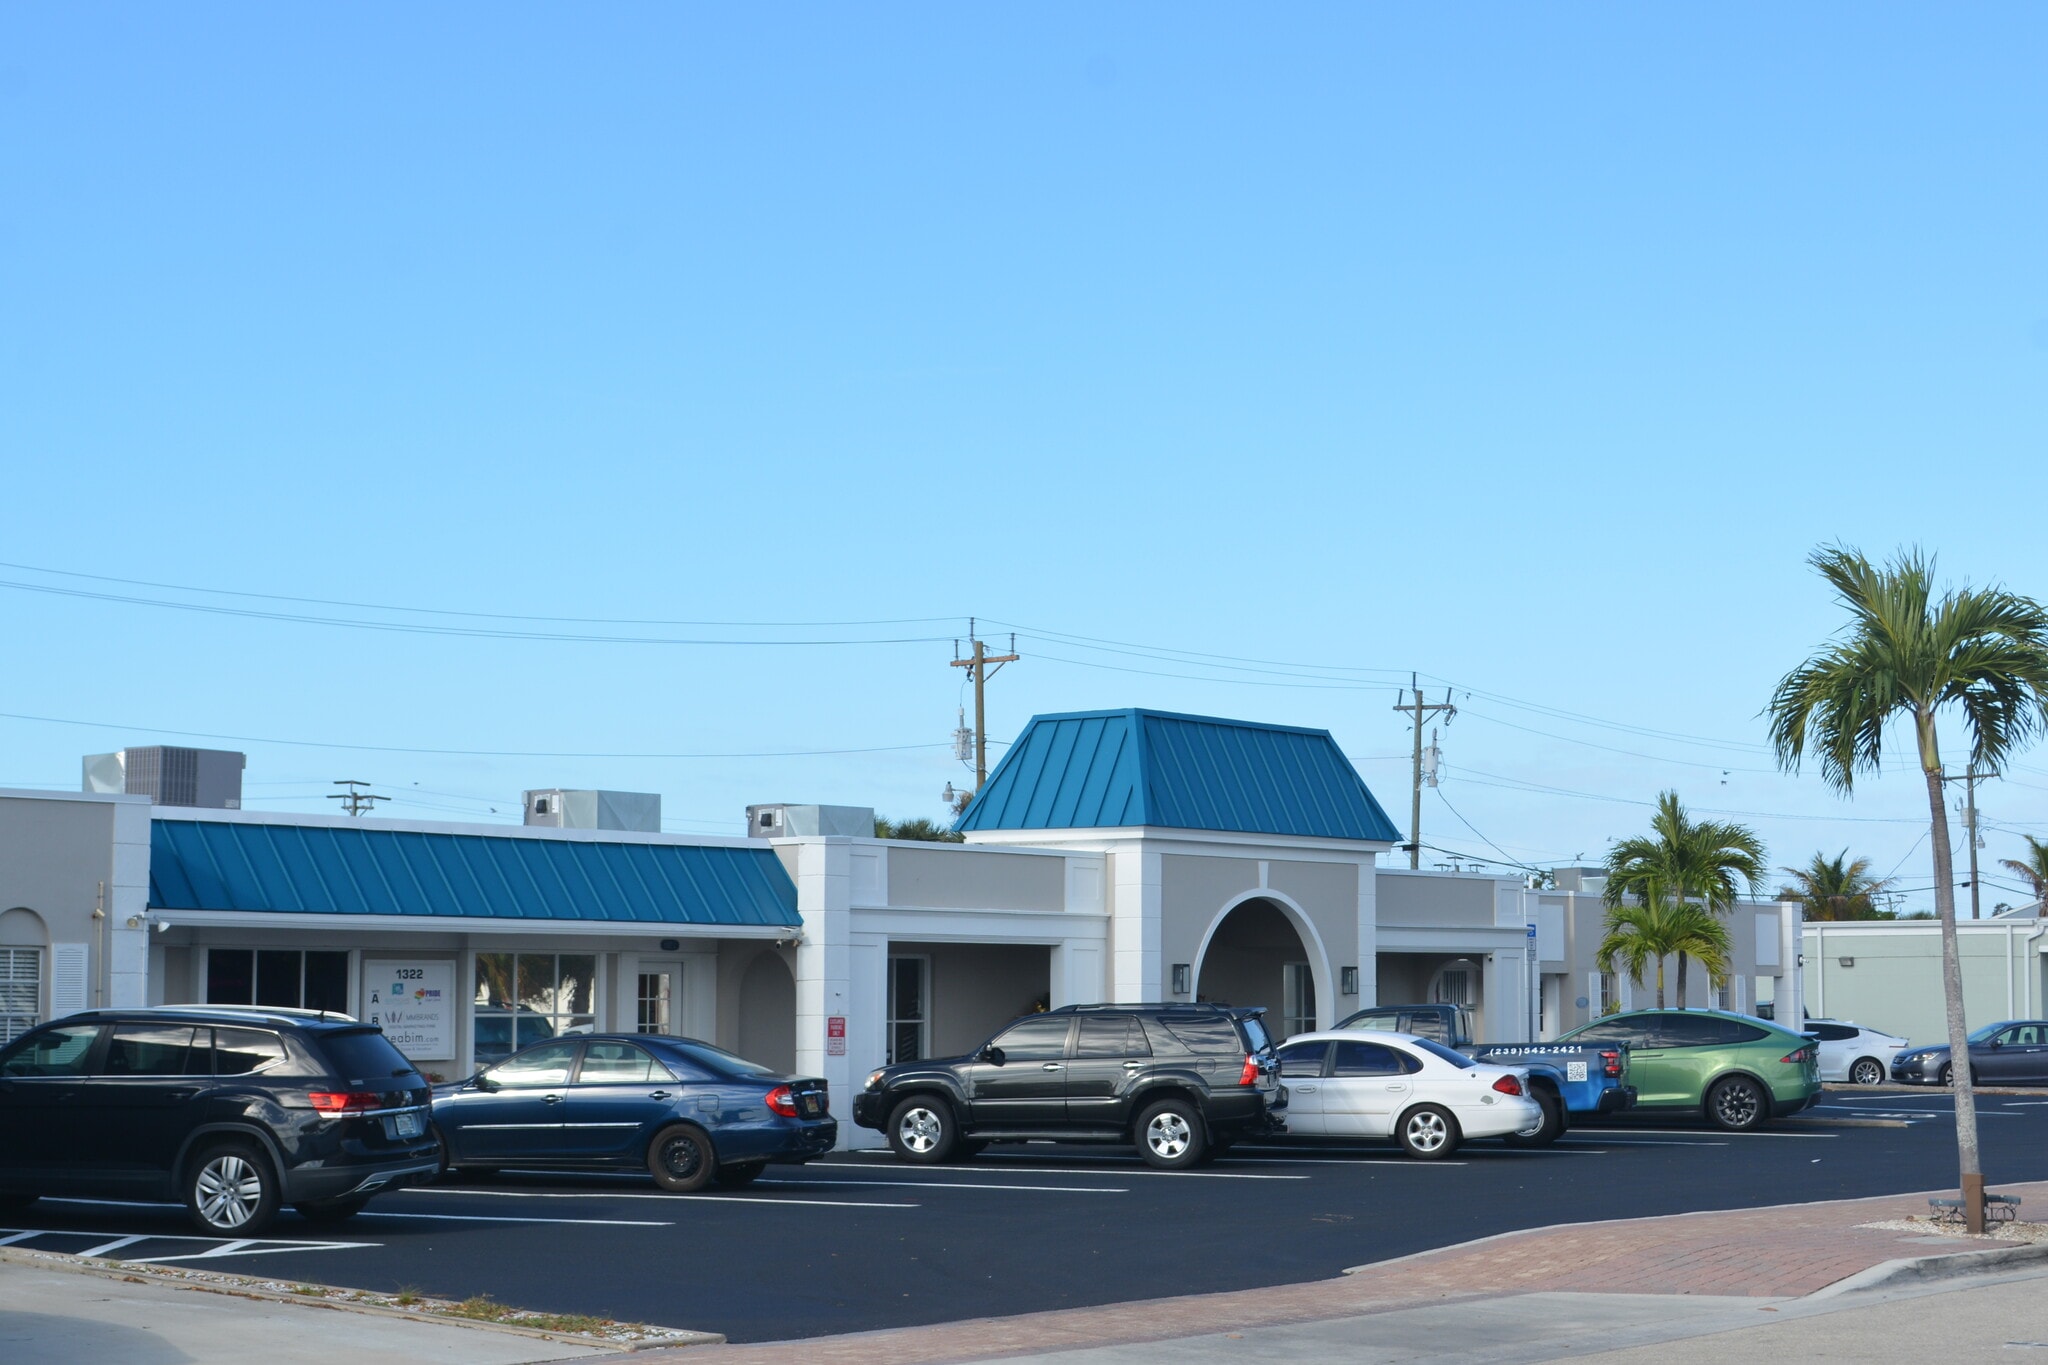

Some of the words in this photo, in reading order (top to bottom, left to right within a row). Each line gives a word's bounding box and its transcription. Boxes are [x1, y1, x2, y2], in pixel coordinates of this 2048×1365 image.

[396, 969, 423, 979] 1322
[371, 993, 379, 1004] A
[1489, 1045, 1582, 1056] (239)542-2421
